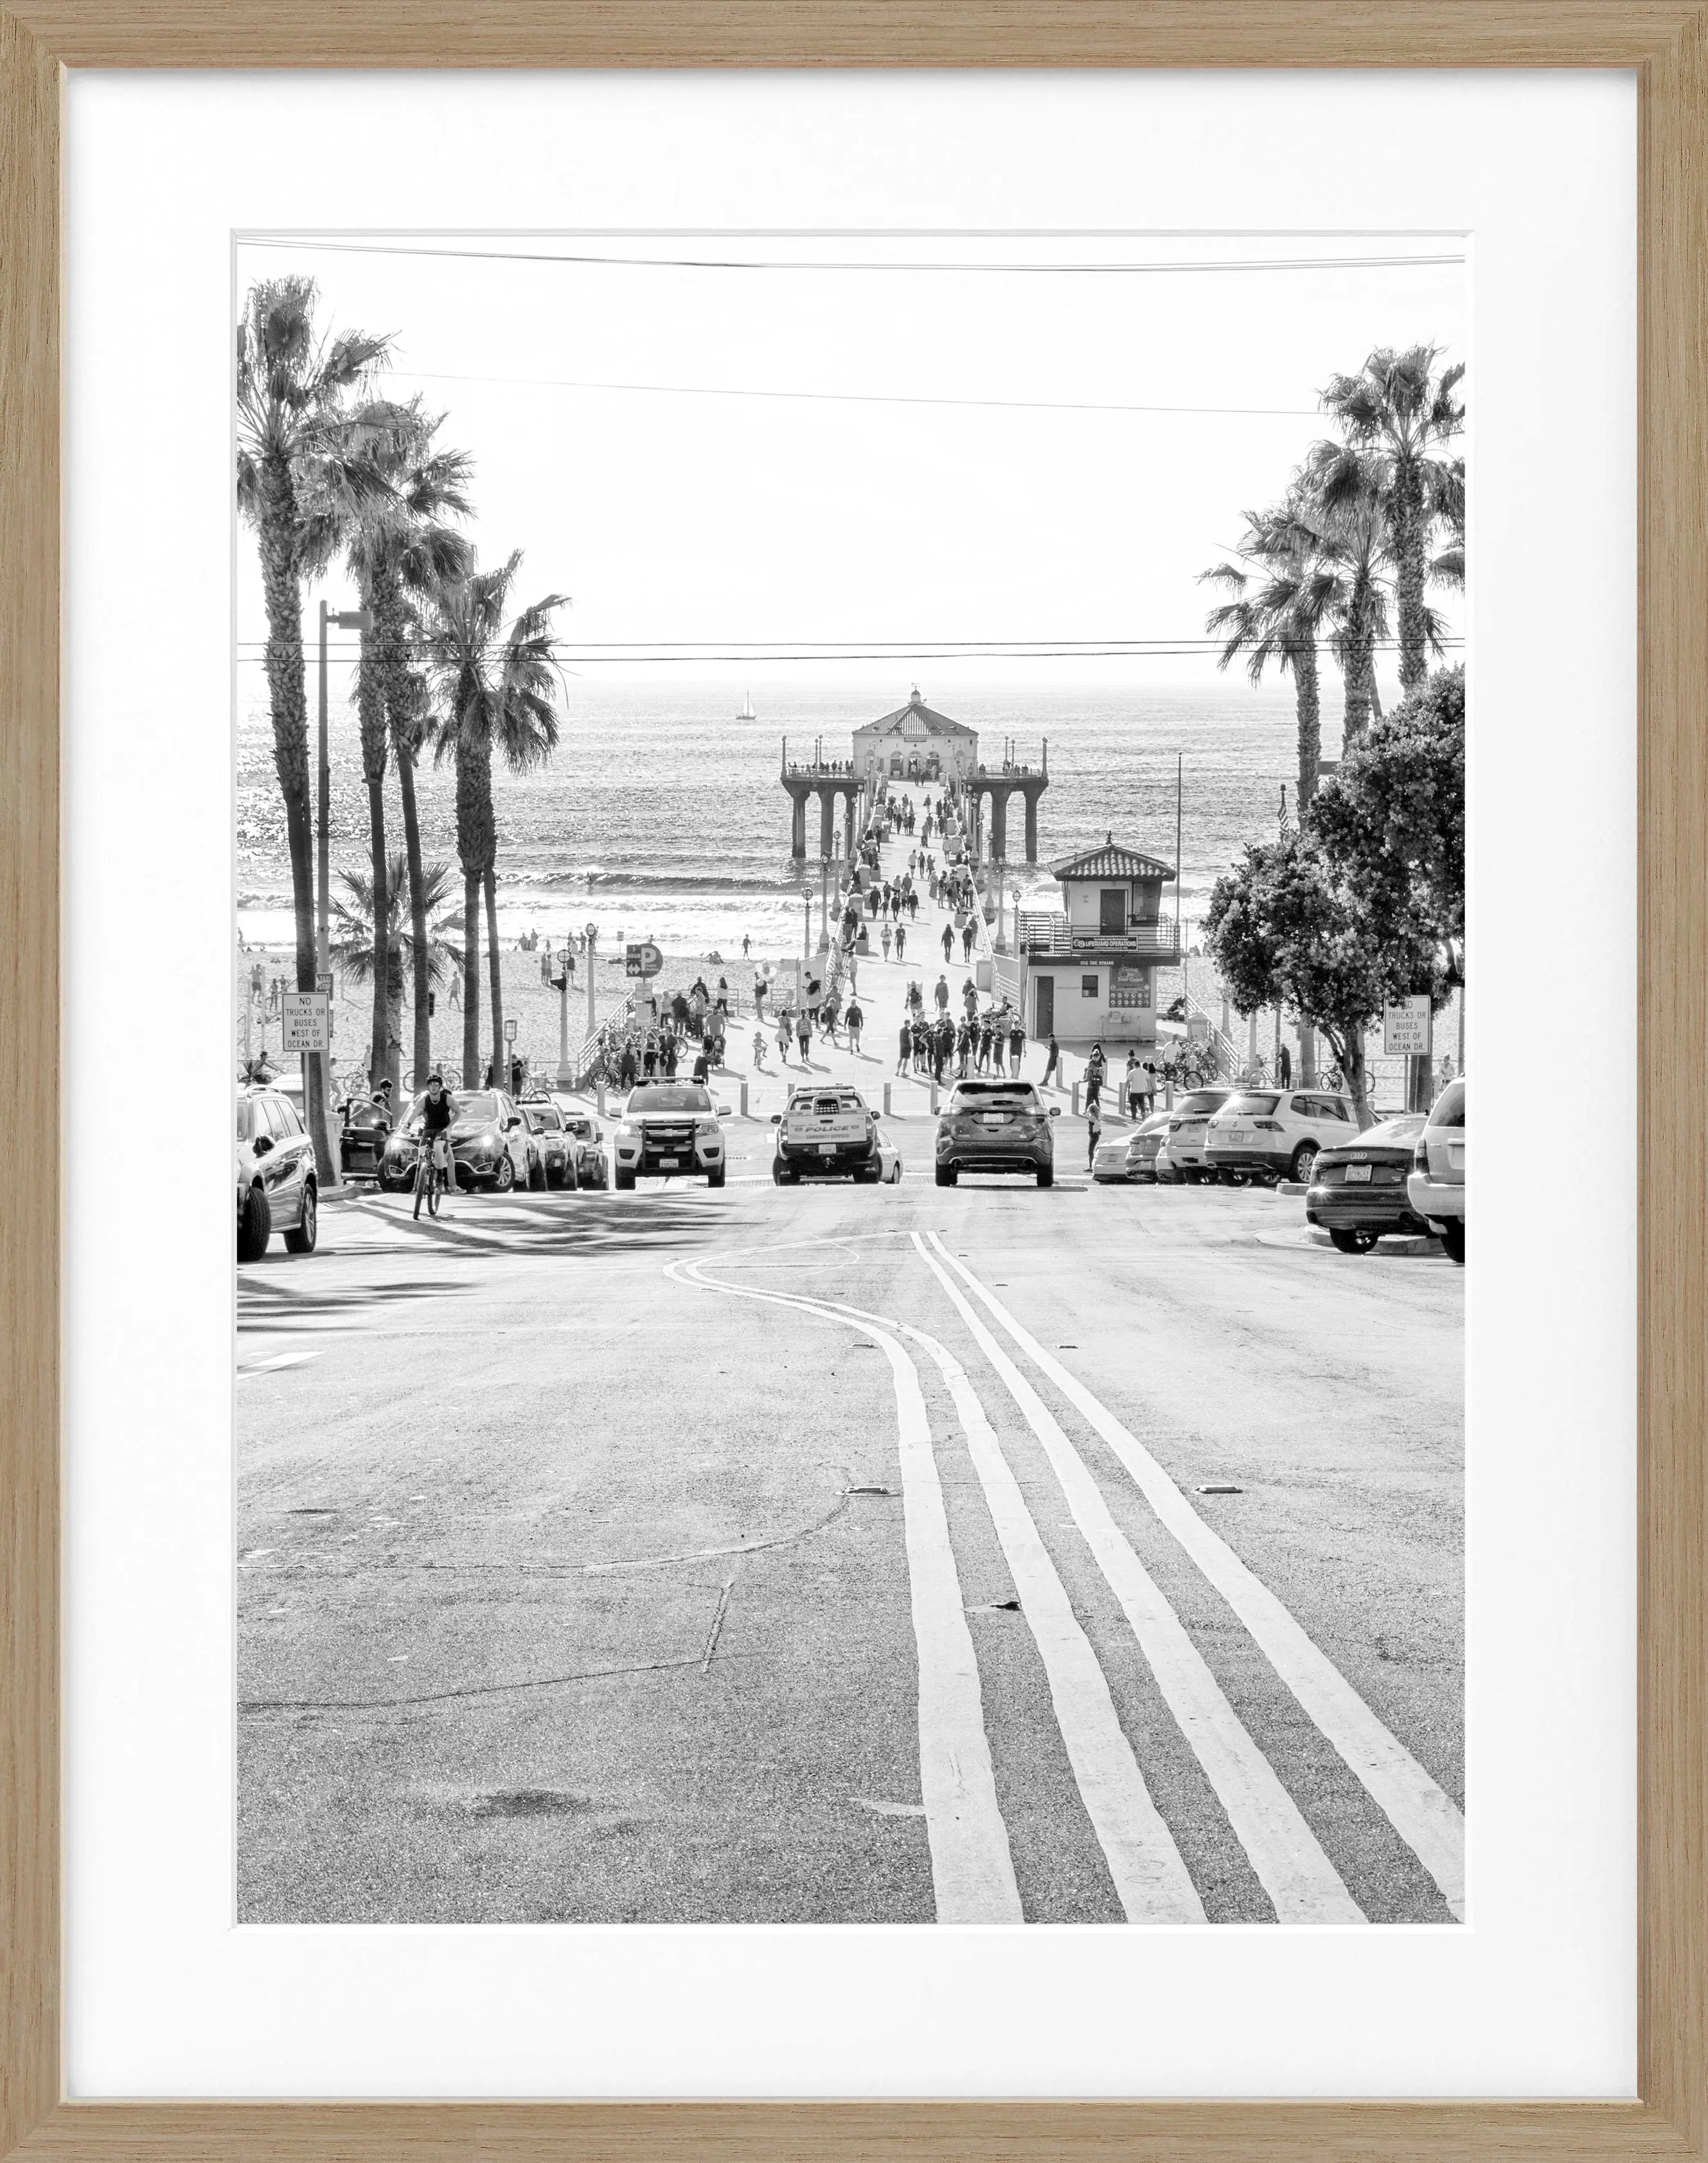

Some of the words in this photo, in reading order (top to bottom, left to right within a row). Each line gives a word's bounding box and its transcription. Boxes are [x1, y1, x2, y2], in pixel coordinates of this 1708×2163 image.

[641, 947, 657, 971] P
[299, 997, 311, 1006] NO
[294, 1019, 317, 1027] BUSES
[290, 1029, 309, 1037] WEST
[312, 1029, 321, 1037] OF
[1392, 1032, 1410, 1040] WEST
[287, 1040, 310, 1048] OCEAN
[1414, 1042, 1425, 1051] DR.
